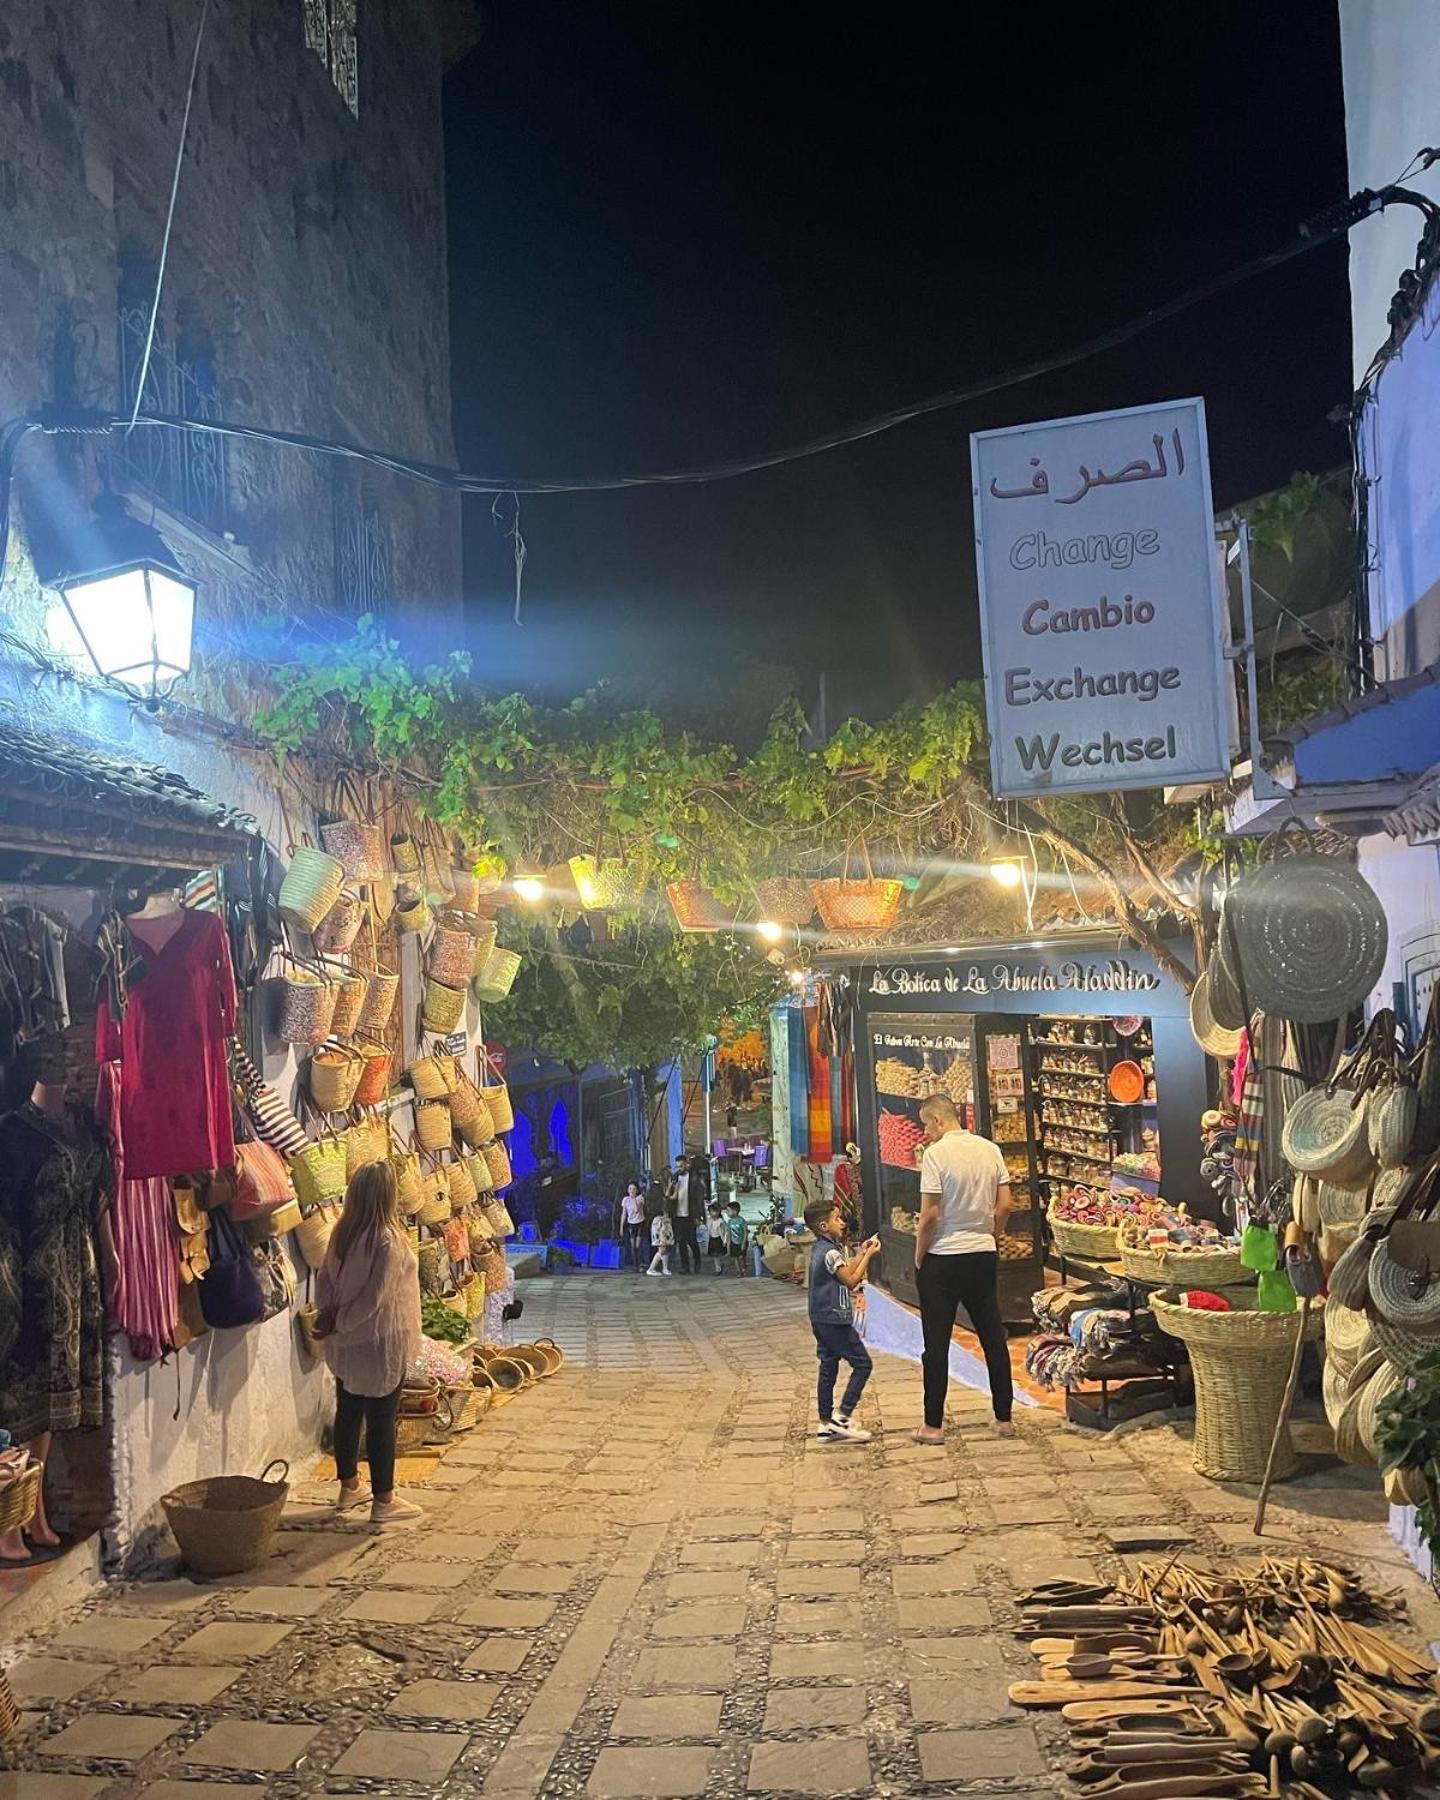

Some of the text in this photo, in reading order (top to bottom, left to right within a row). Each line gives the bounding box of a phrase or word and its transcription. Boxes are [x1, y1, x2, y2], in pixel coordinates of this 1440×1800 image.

[990, 428, 1184, 504] الصرف
[1009, 529, 1160, 570] Change
[1022, 595, 1155, 635] Cambio
[1005, 666, 1181, 706] Exchange
[1015, 725, 1176, 770] Wechsel
[868, 970, 890, 995] La
[944, 967, 959, 992] de
[962, 966, 989, 995] La
[992, 964, 1056, 992] Abuela
[1058, 960, 1159, 992] Aladdin
